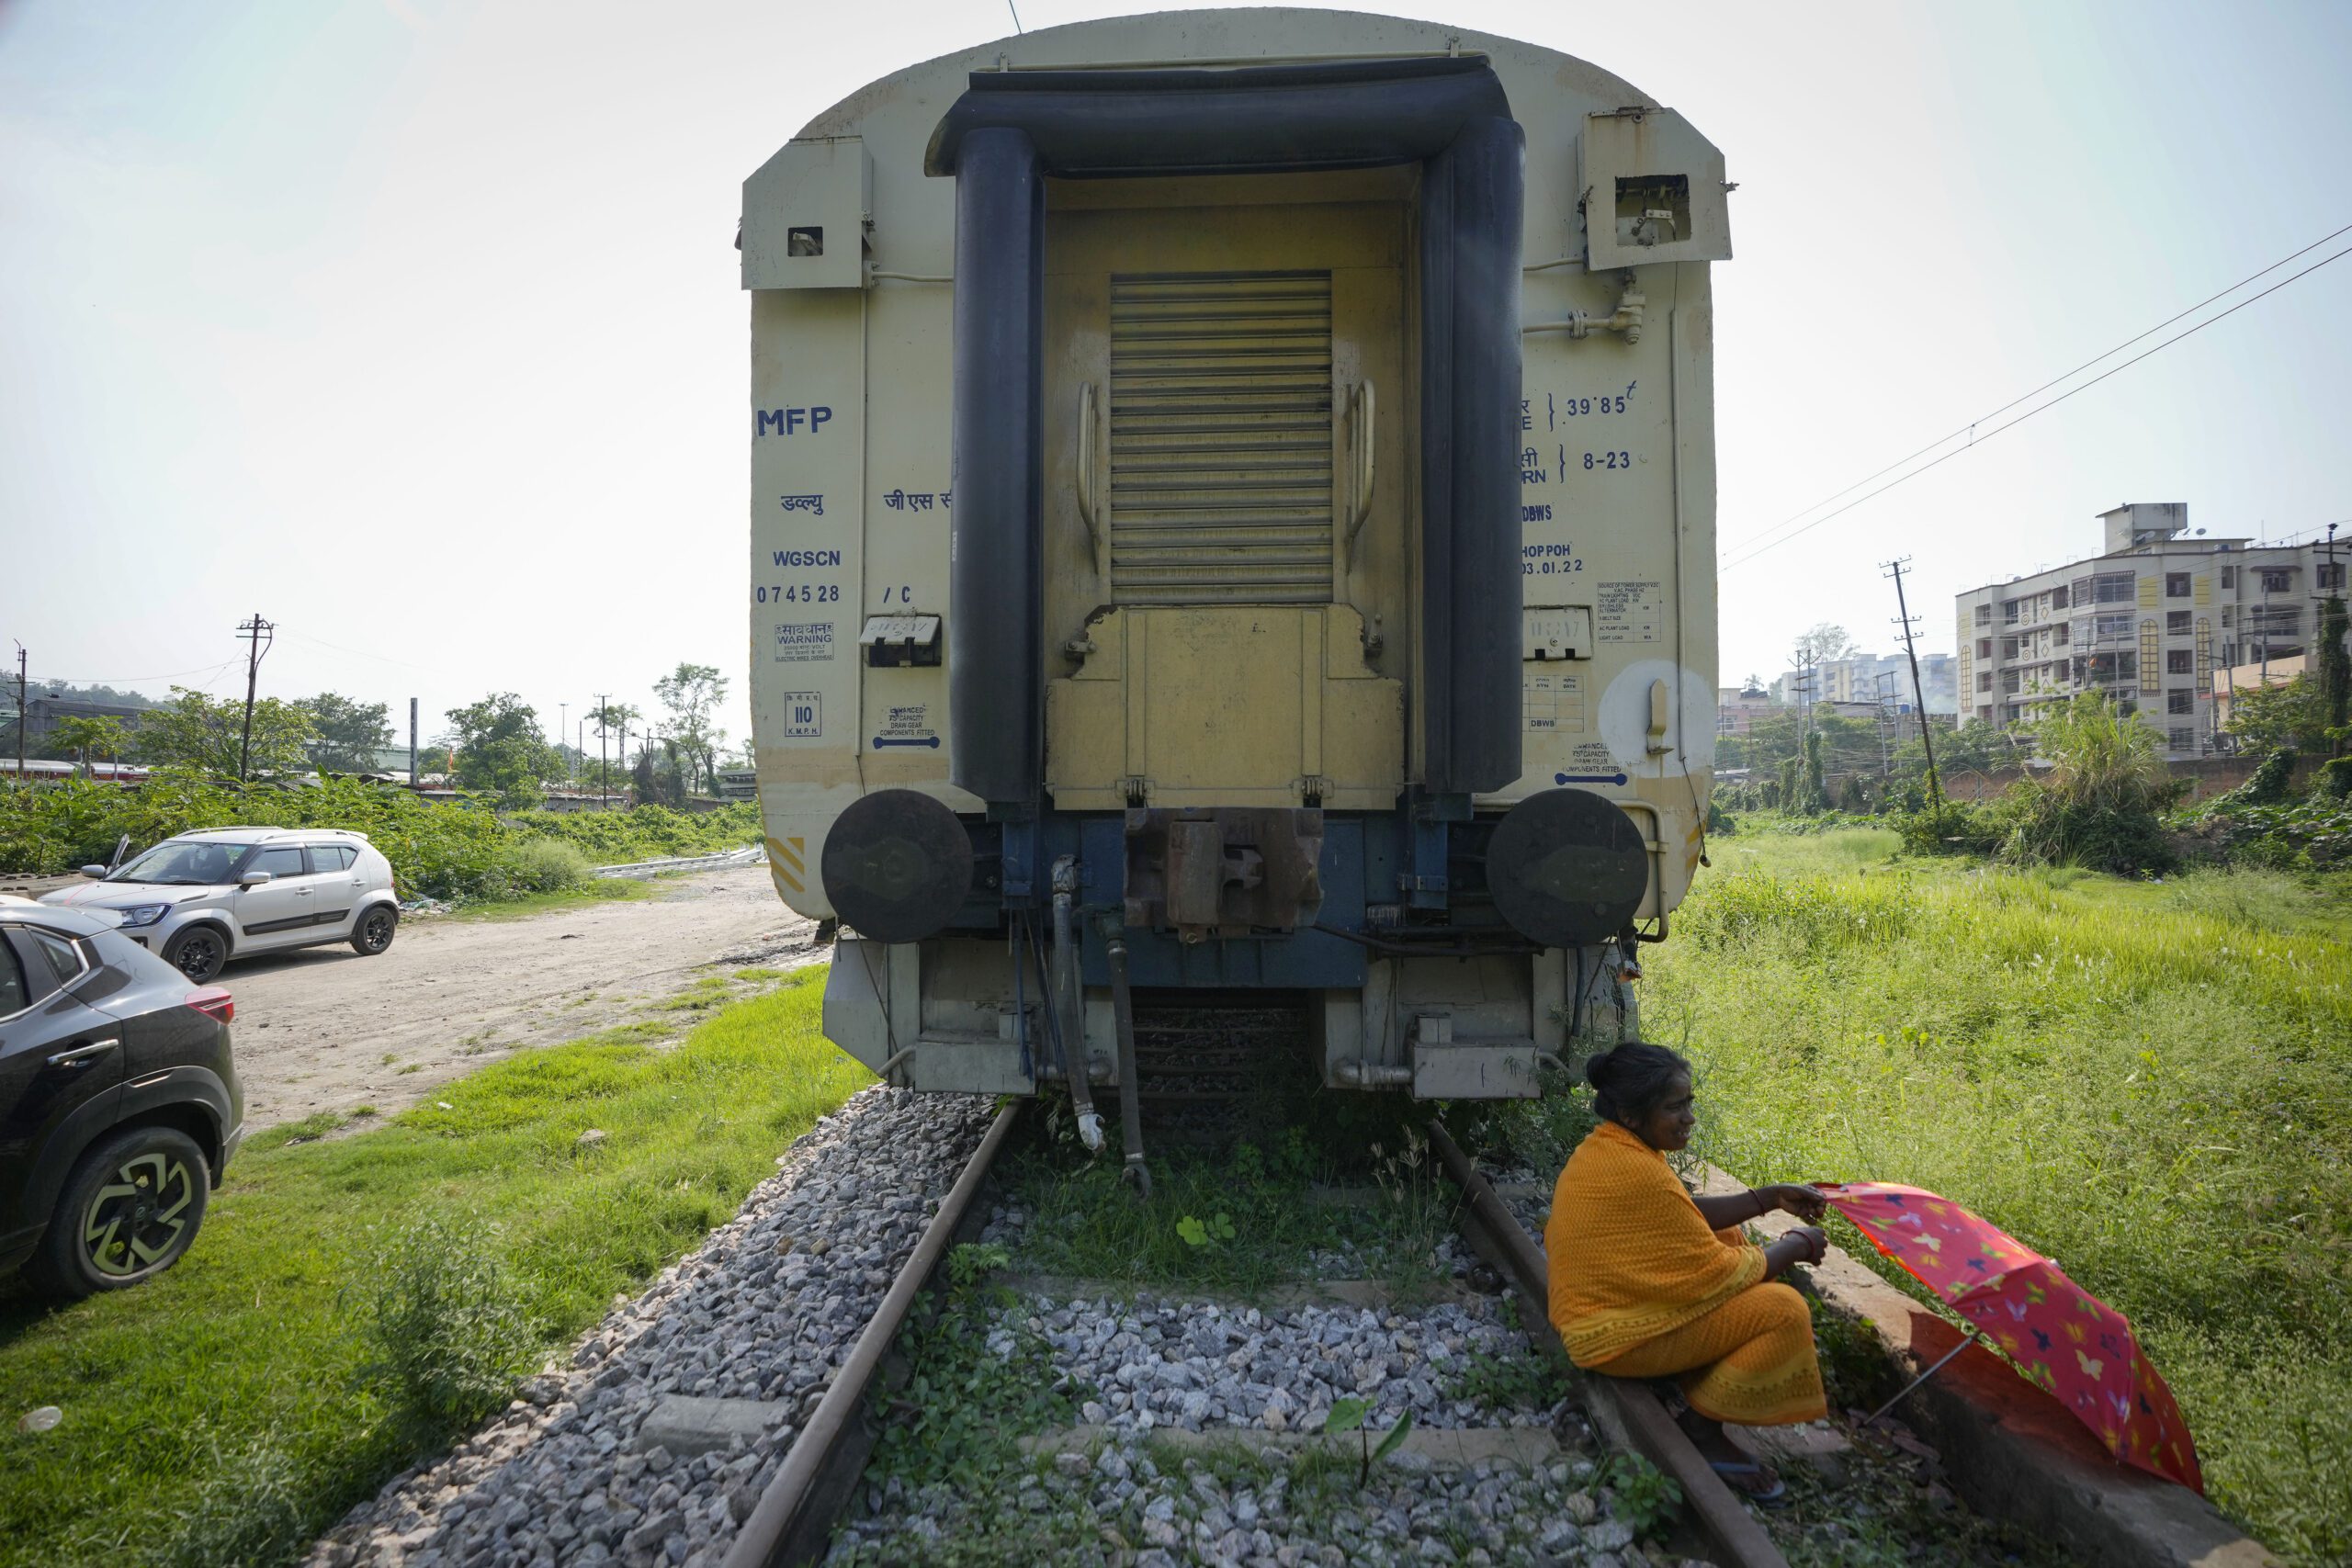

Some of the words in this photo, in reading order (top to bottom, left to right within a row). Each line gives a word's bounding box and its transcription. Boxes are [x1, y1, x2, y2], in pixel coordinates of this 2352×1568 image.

[757, 406, 832, 436] MFP
[1584, 452, 1630, 469] 8-23
[773, 550, 841, 567] WGSCN
[1546, 544, 1570, 557] POH
[757, 585, 839, 603] 074528
[901, 586, 910, 603] C
[777, 634, 831, 644] WARNING
